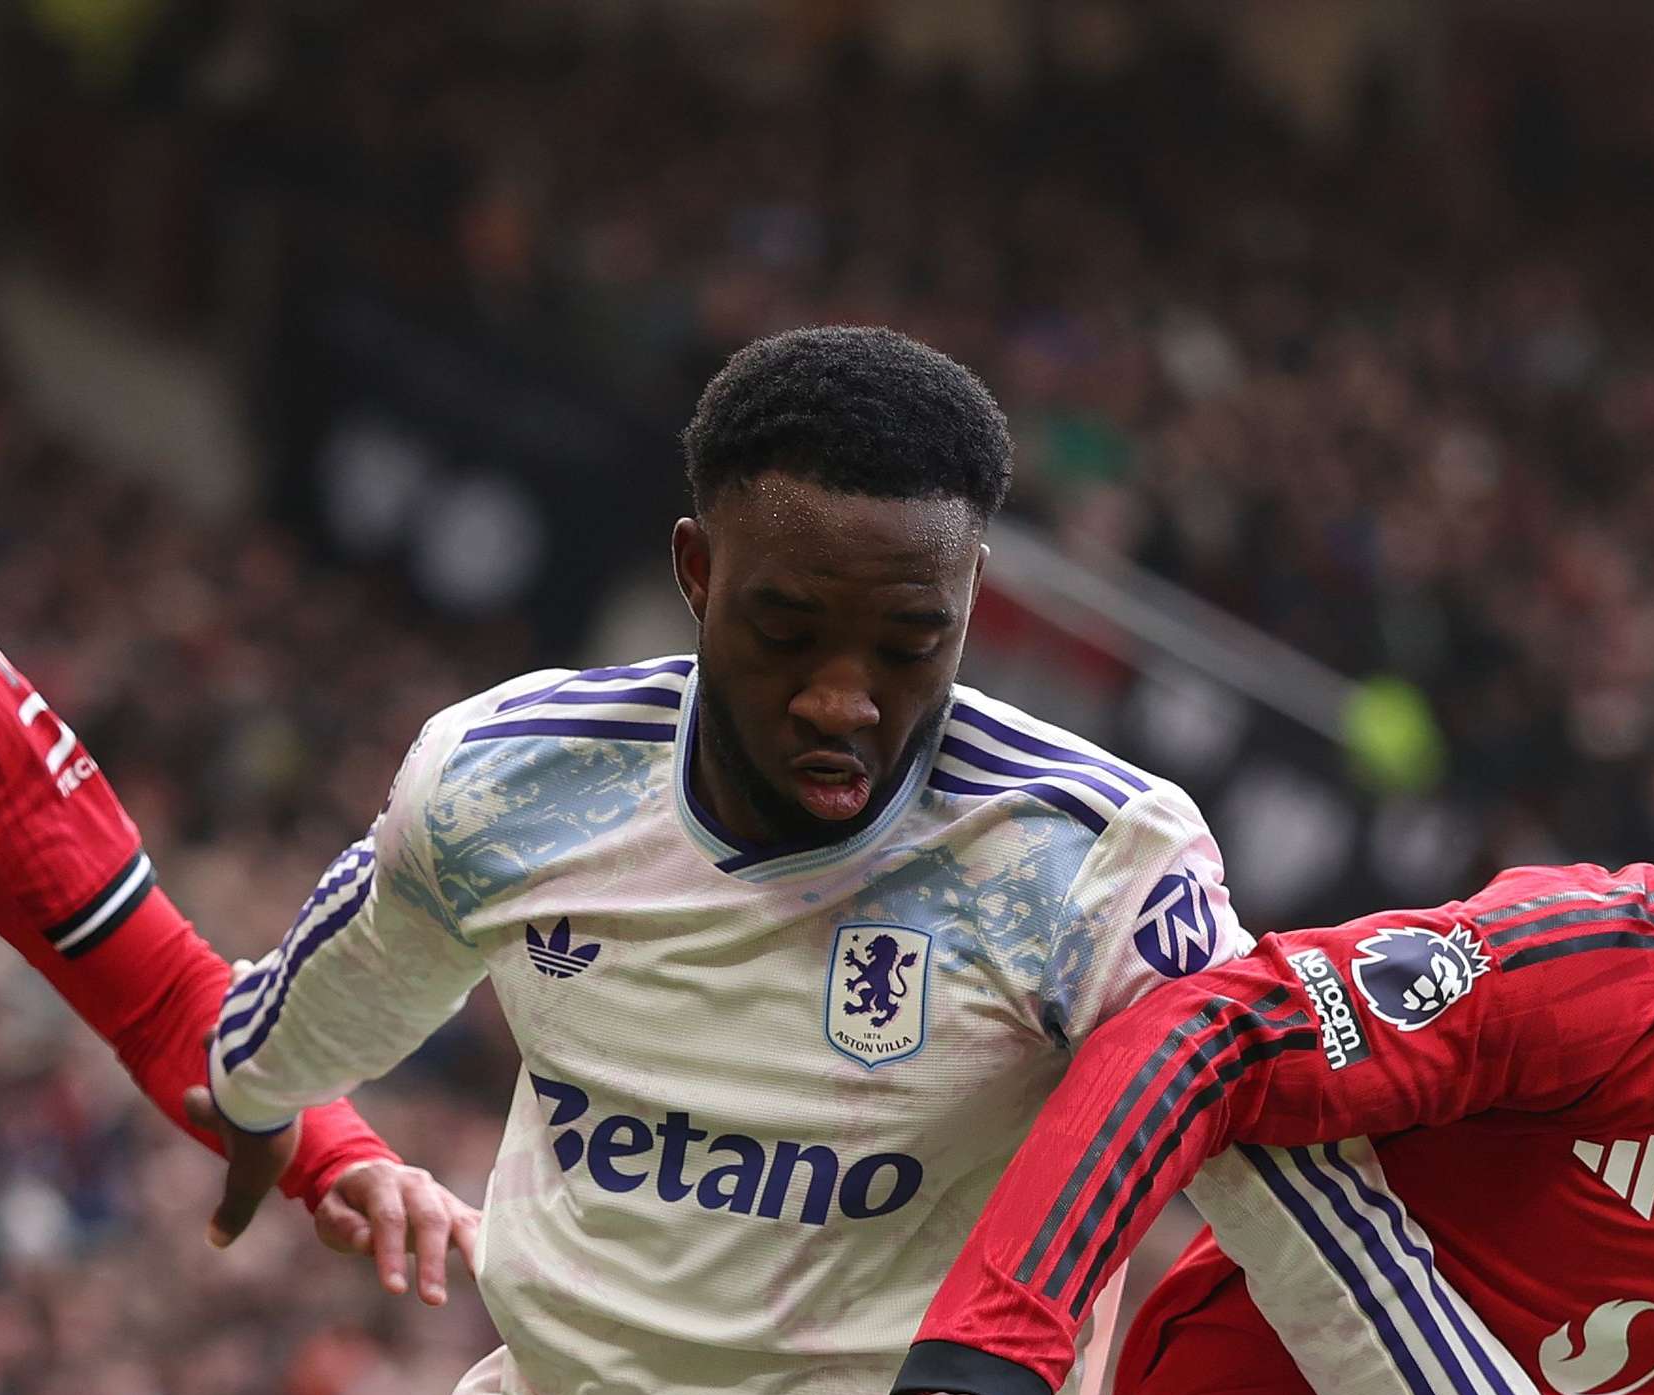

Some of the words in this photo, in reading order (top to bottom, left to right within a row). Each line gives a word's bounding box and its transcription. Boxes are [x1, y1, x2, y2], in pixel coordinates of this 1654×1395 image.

[835, 1030, 873, 1054] ASTON
[876, 1035, 913, 1054] VILLA
[1317, 975, 1361, 1051] room
[529, 1071, 924, 1226] Betano
